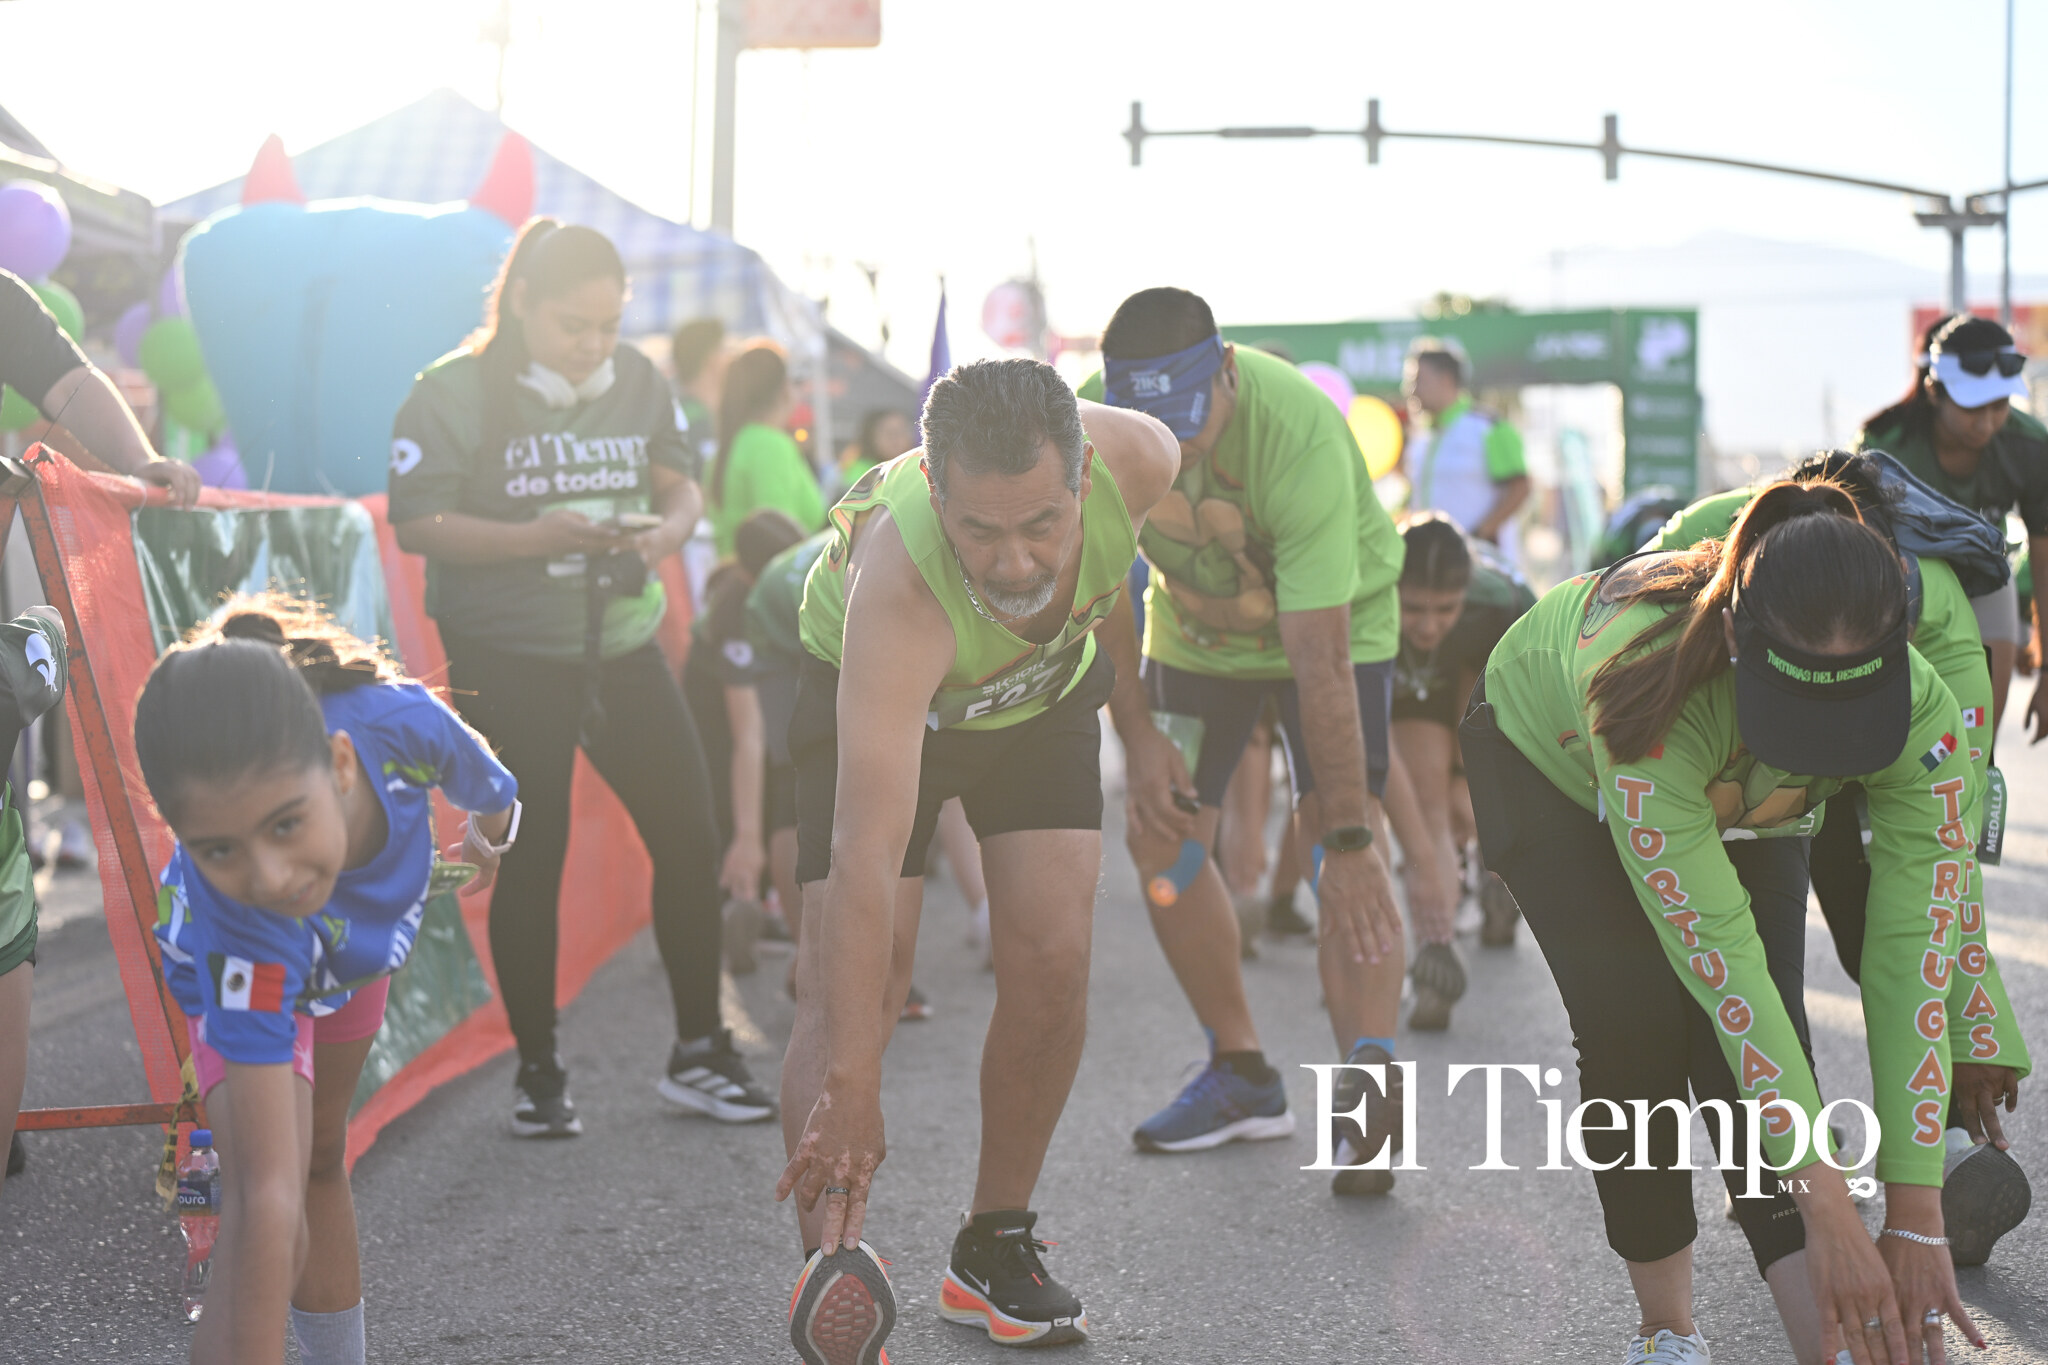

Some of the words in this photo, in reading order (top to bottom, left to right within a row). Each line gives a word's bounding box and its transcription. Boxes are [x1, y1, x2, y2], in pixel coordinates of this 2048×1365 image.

[504, 433, 541, 469] El
[504, 472, 550, 497] de
[553, 466, 638, 494] todos
[1766, 648, 1812, 683] TORTUGAS
[1812, 671, 1835, 684] DEL
[1985, 783, 2002, 853] MEDALLA
[1615, 775, 1795, 1137] TORTUGAS
[1906, 776, 1967, 1147] TORTUGAS
